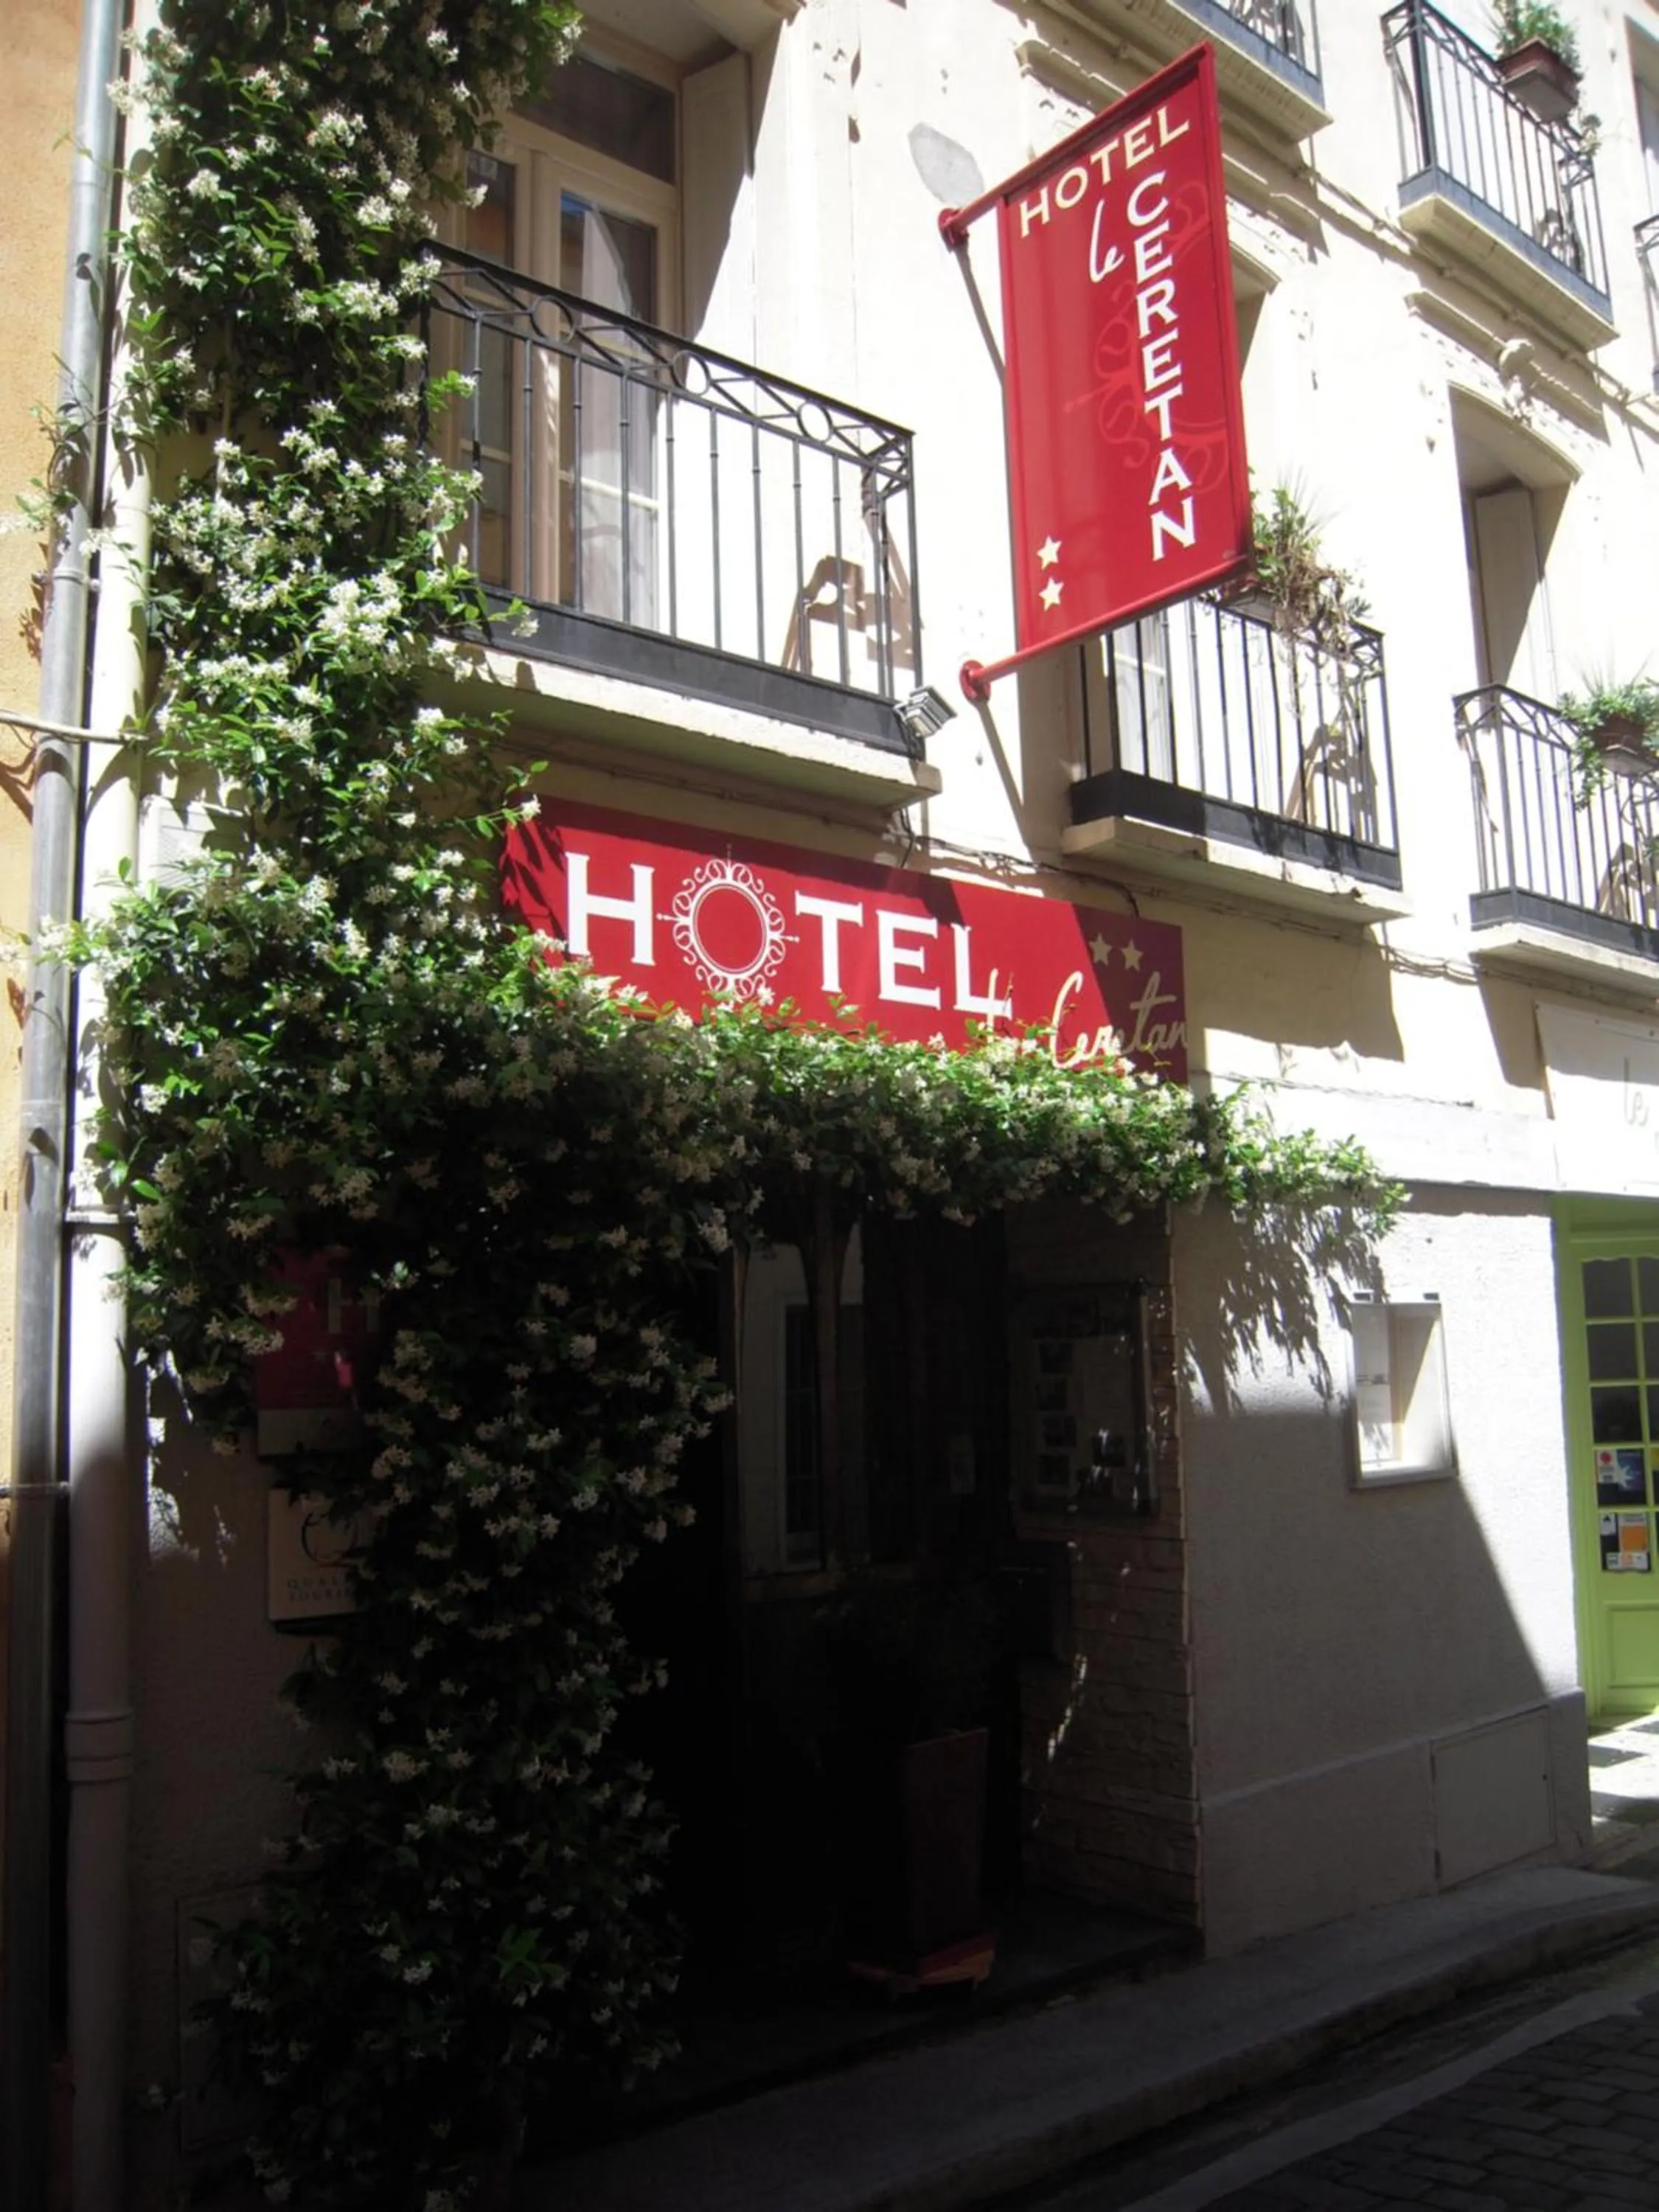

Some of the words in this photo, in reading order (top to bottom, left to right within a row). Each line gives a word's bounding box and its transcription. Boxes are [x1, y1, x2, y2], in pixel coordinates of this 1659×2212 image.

[1019, 105, 1190, 237] HOTEL
[1127, 170, 1196, 563] CERETAN
[563, 848, 1014, 1019] HOTEL
